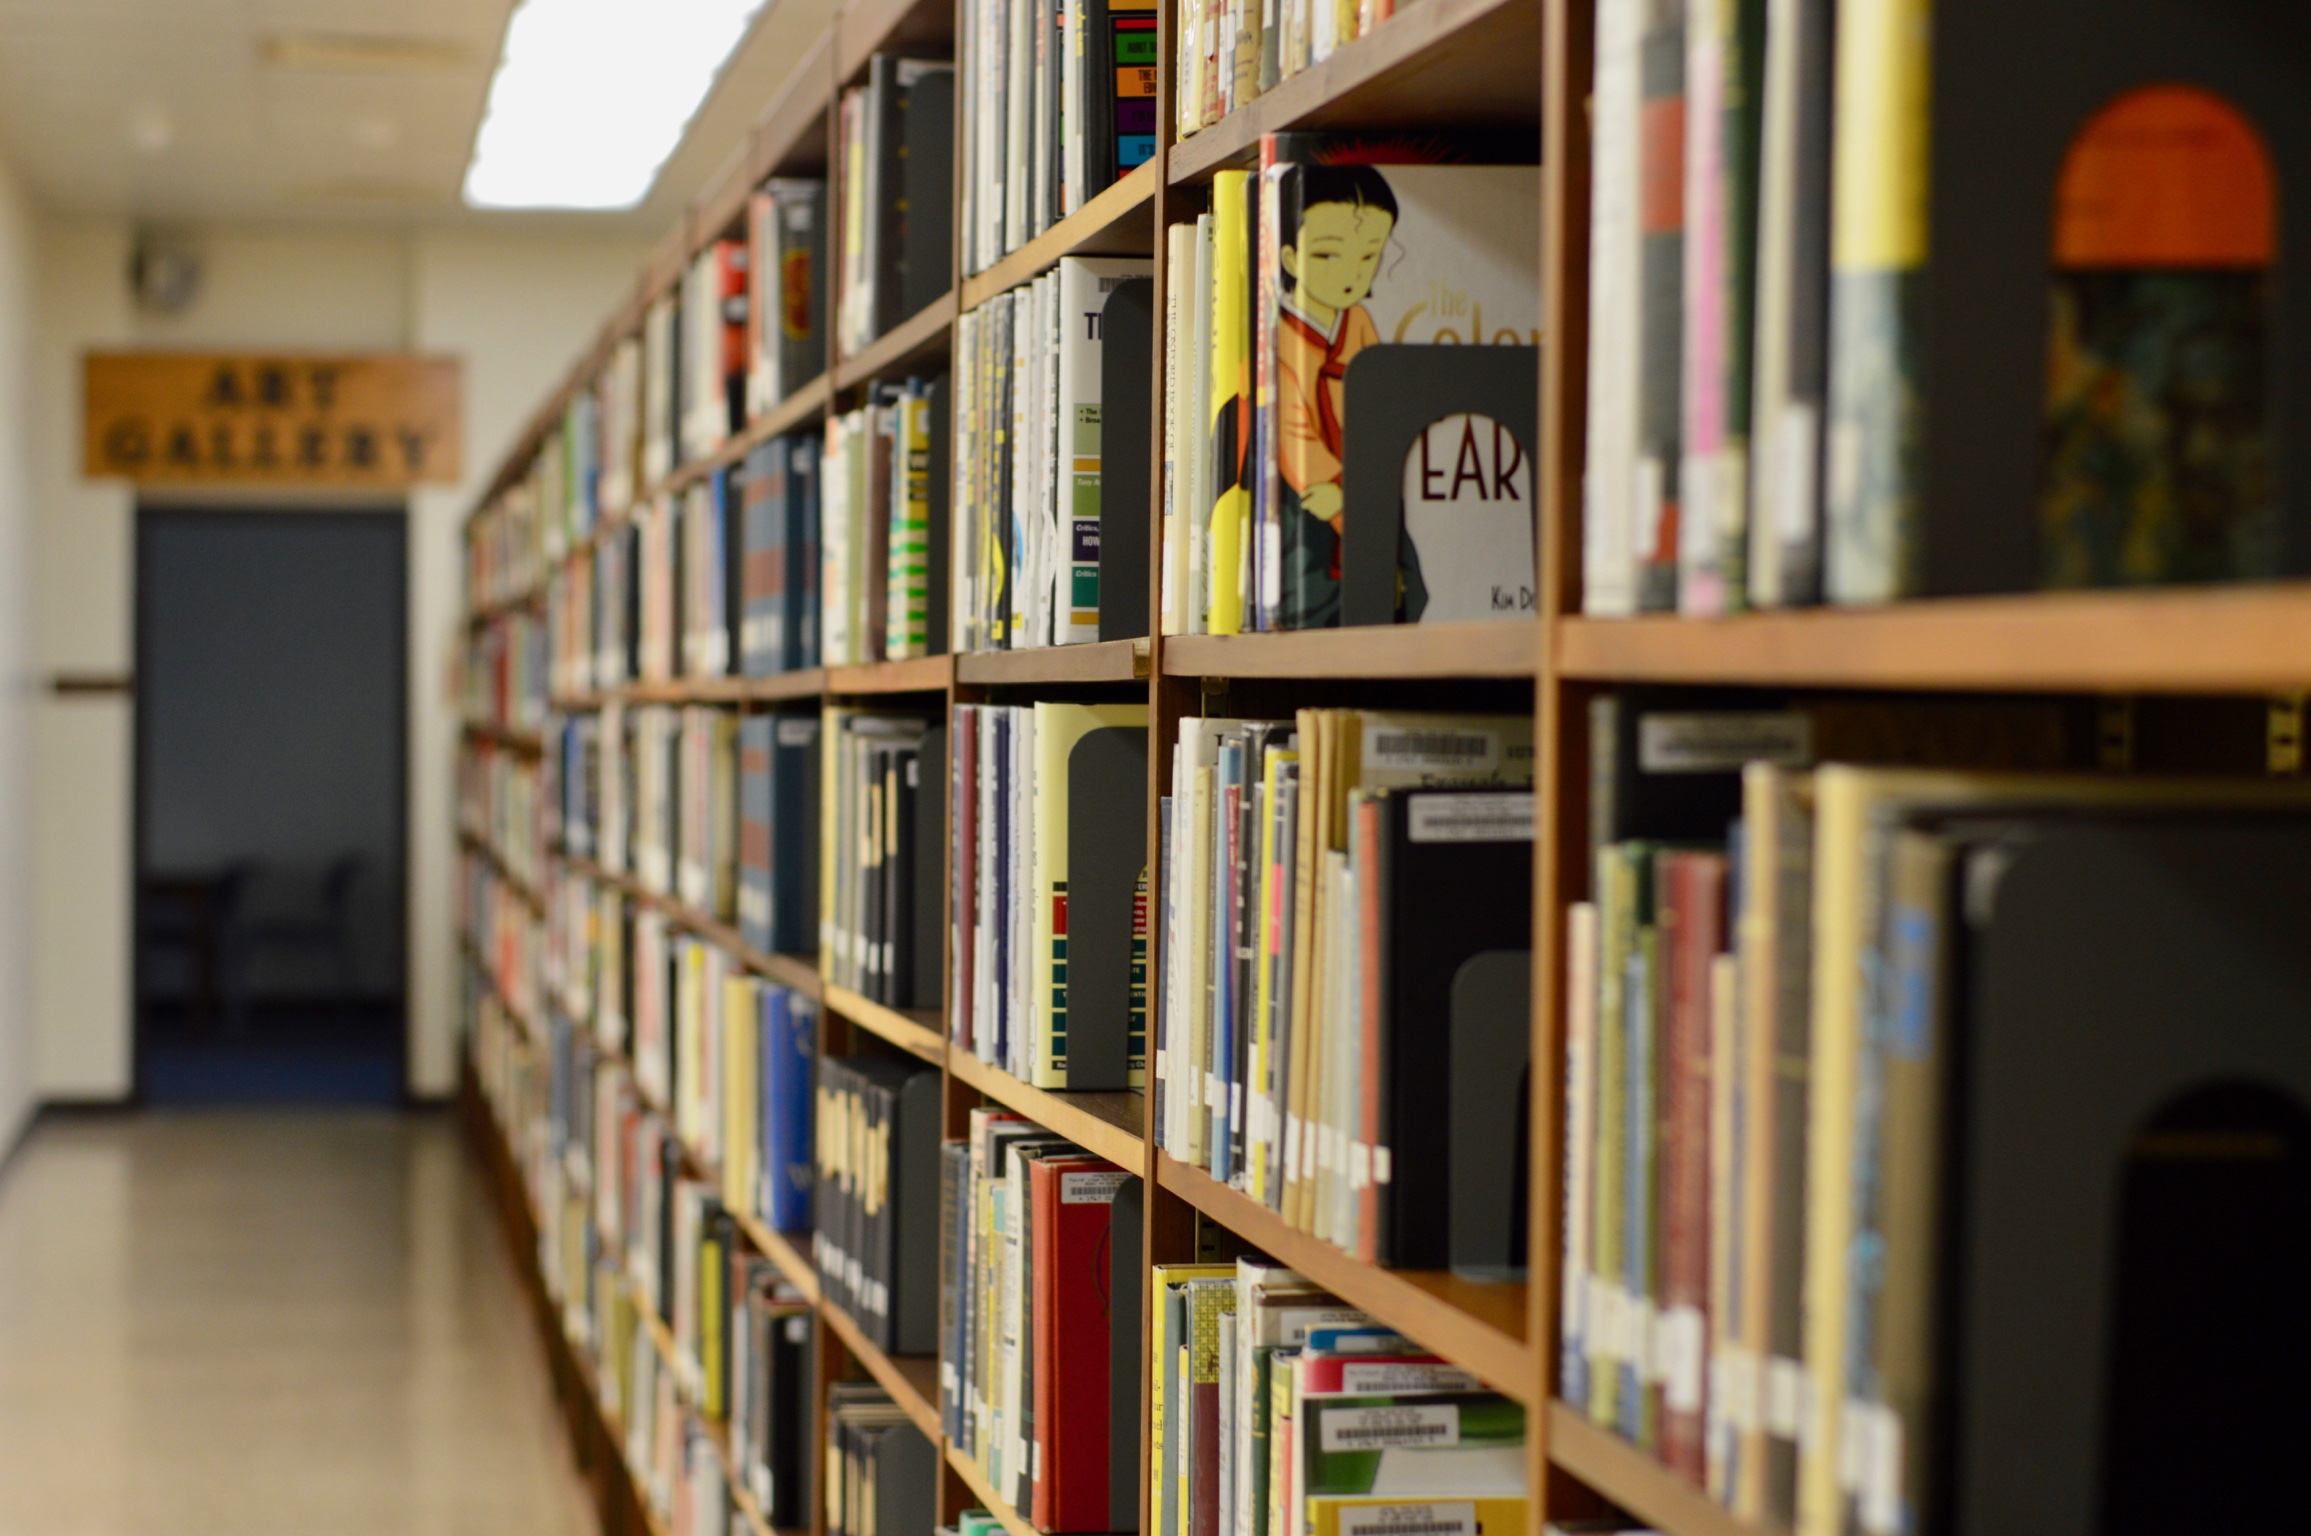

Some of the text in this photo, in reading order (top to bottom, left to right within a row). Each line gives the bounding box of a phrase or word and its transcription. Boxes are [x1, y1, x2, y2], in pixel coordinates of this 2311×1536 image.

[1430, 279, 1467, 317] The
[205, 362, 342, 408] ART
[104, 416, 436, 470] GALLERY
[1075, 569, 1097, 578] Critics
[1491, 585, 1514, 610] Kim
